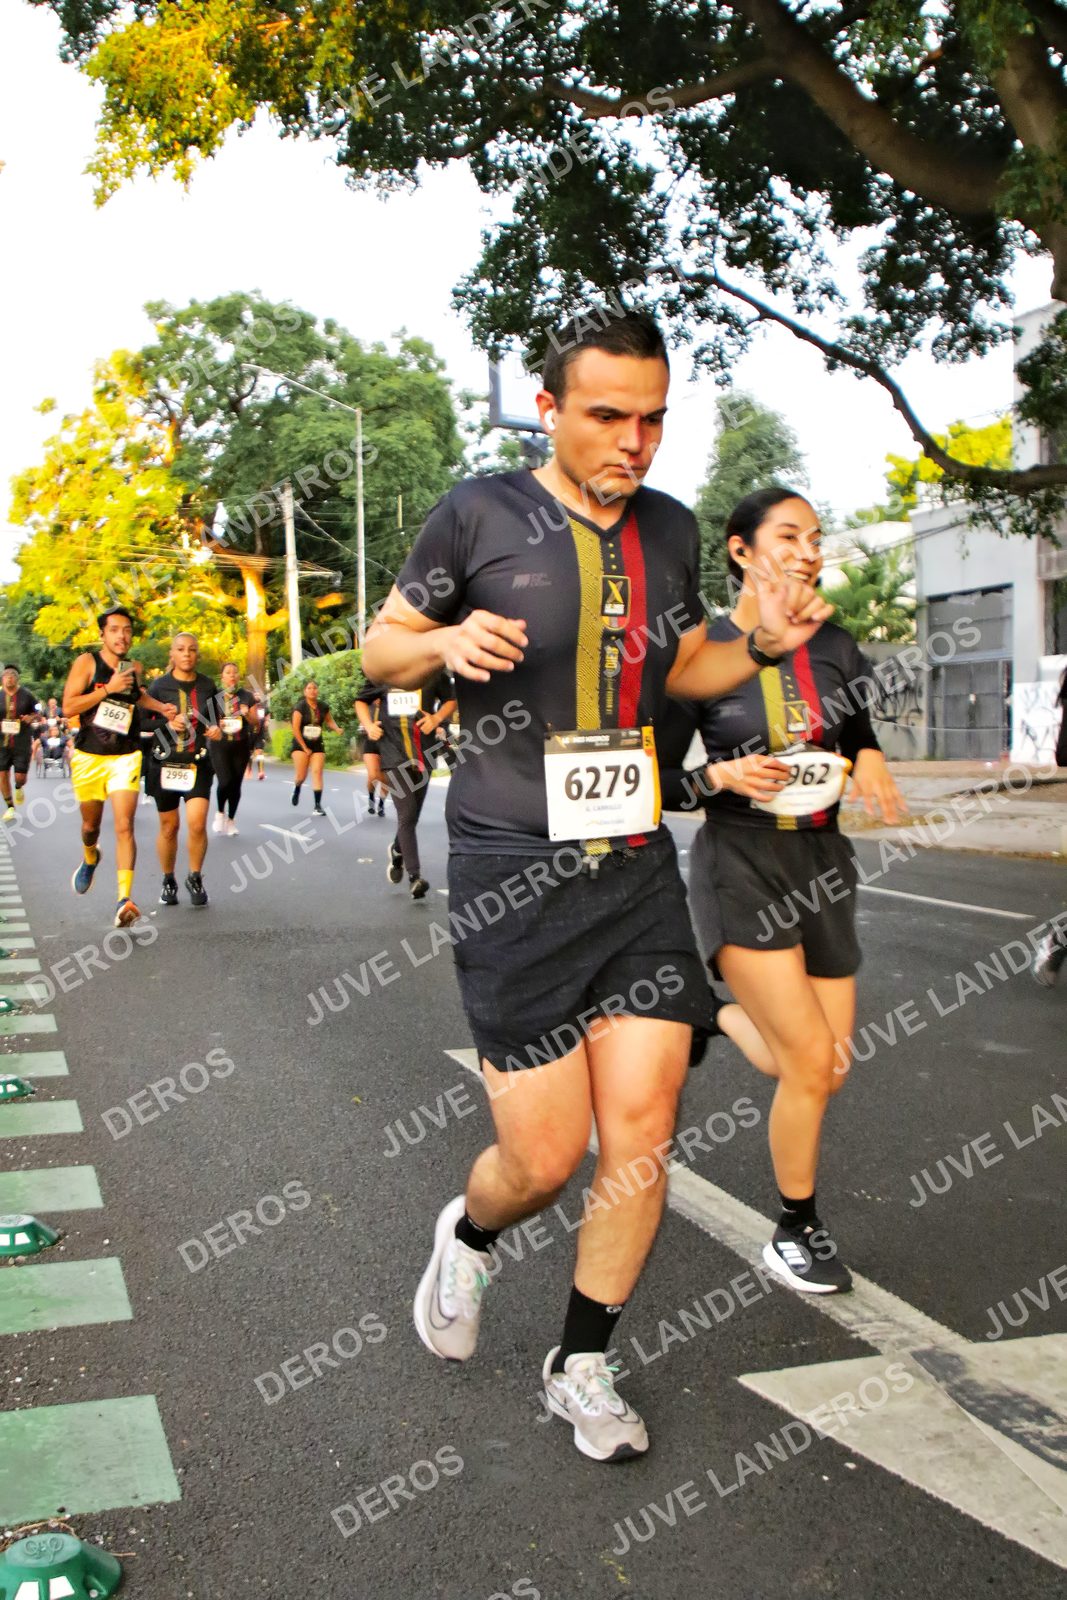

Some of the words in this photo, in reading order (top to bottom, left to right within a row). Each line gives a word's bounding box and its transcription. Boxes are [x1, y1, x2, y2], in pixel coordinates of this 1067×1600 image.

[102, 706, 127, 721] 3667
[165, 770, 189, 781] 2996
[564, 763, 641, 801] 6279
[779, 762, 831, 787] 962
